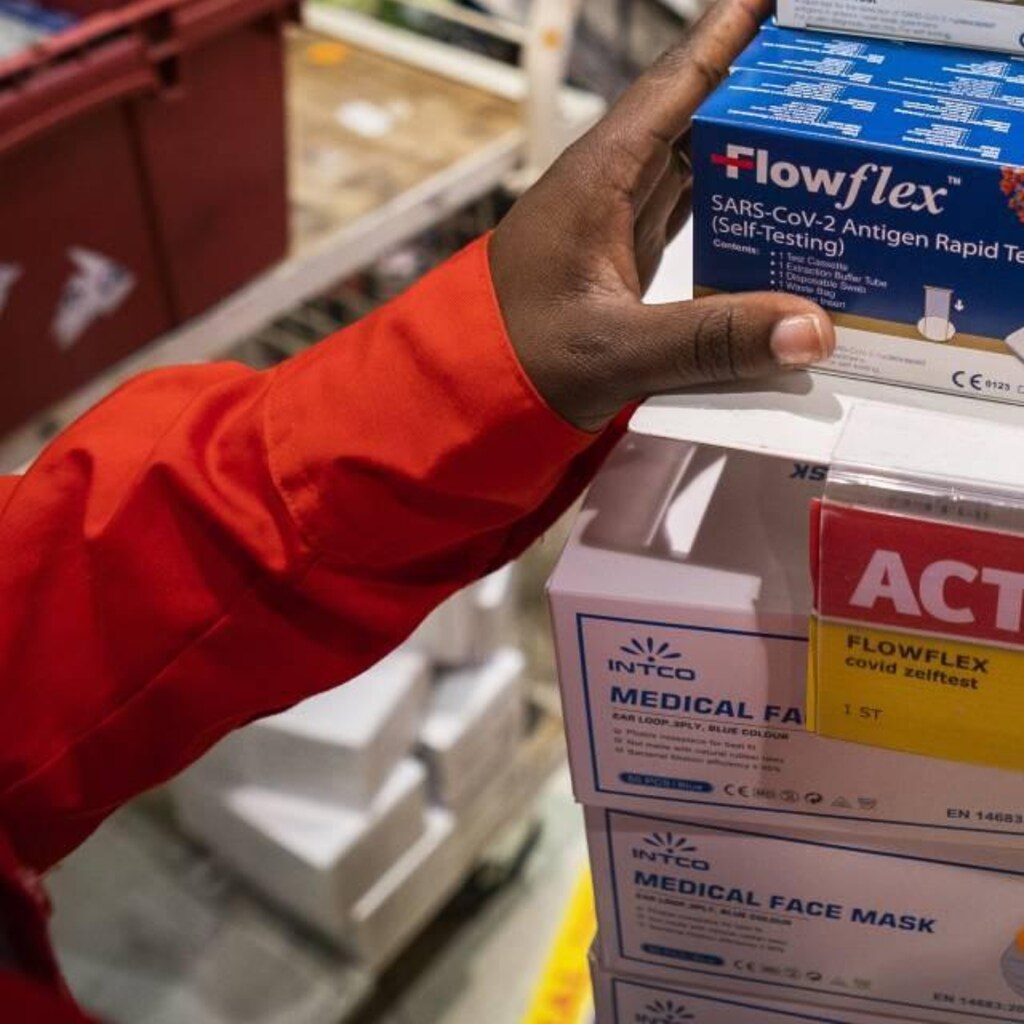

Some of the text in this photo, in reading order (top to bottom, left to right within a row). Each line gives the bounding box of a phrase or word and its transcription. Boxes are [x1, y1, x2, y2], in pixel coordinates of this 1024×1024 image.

[711, 143, 947, 215] Flowflex
[712, 195, 836, 231] SARS-CoV-2
[842, 218, 928, 248] Antigen
[935, 234, 999, 260] Rapid
[712, 216, 845, 257] (Self-Testing)
[713, 238, 760, 256] Contents:
[985, 380, 1010, 391] 0123
[847, 635, 989, 673] FLOWFLEX
[608, 659, 695, 680] INTCO
[845, 655, 979, 689] covid zelftest
[611, 686, 806, 724] MEDICAL FA
[844, 703, 883, 721] 1 ST
[612, 713, 790, 740] EAR BLUE COLOUR
[947, 808, 970, 820] EN
[632, 847, 710, 871] INTCO
[634, 871, 936, 933] MEDICAL FACE MASK
